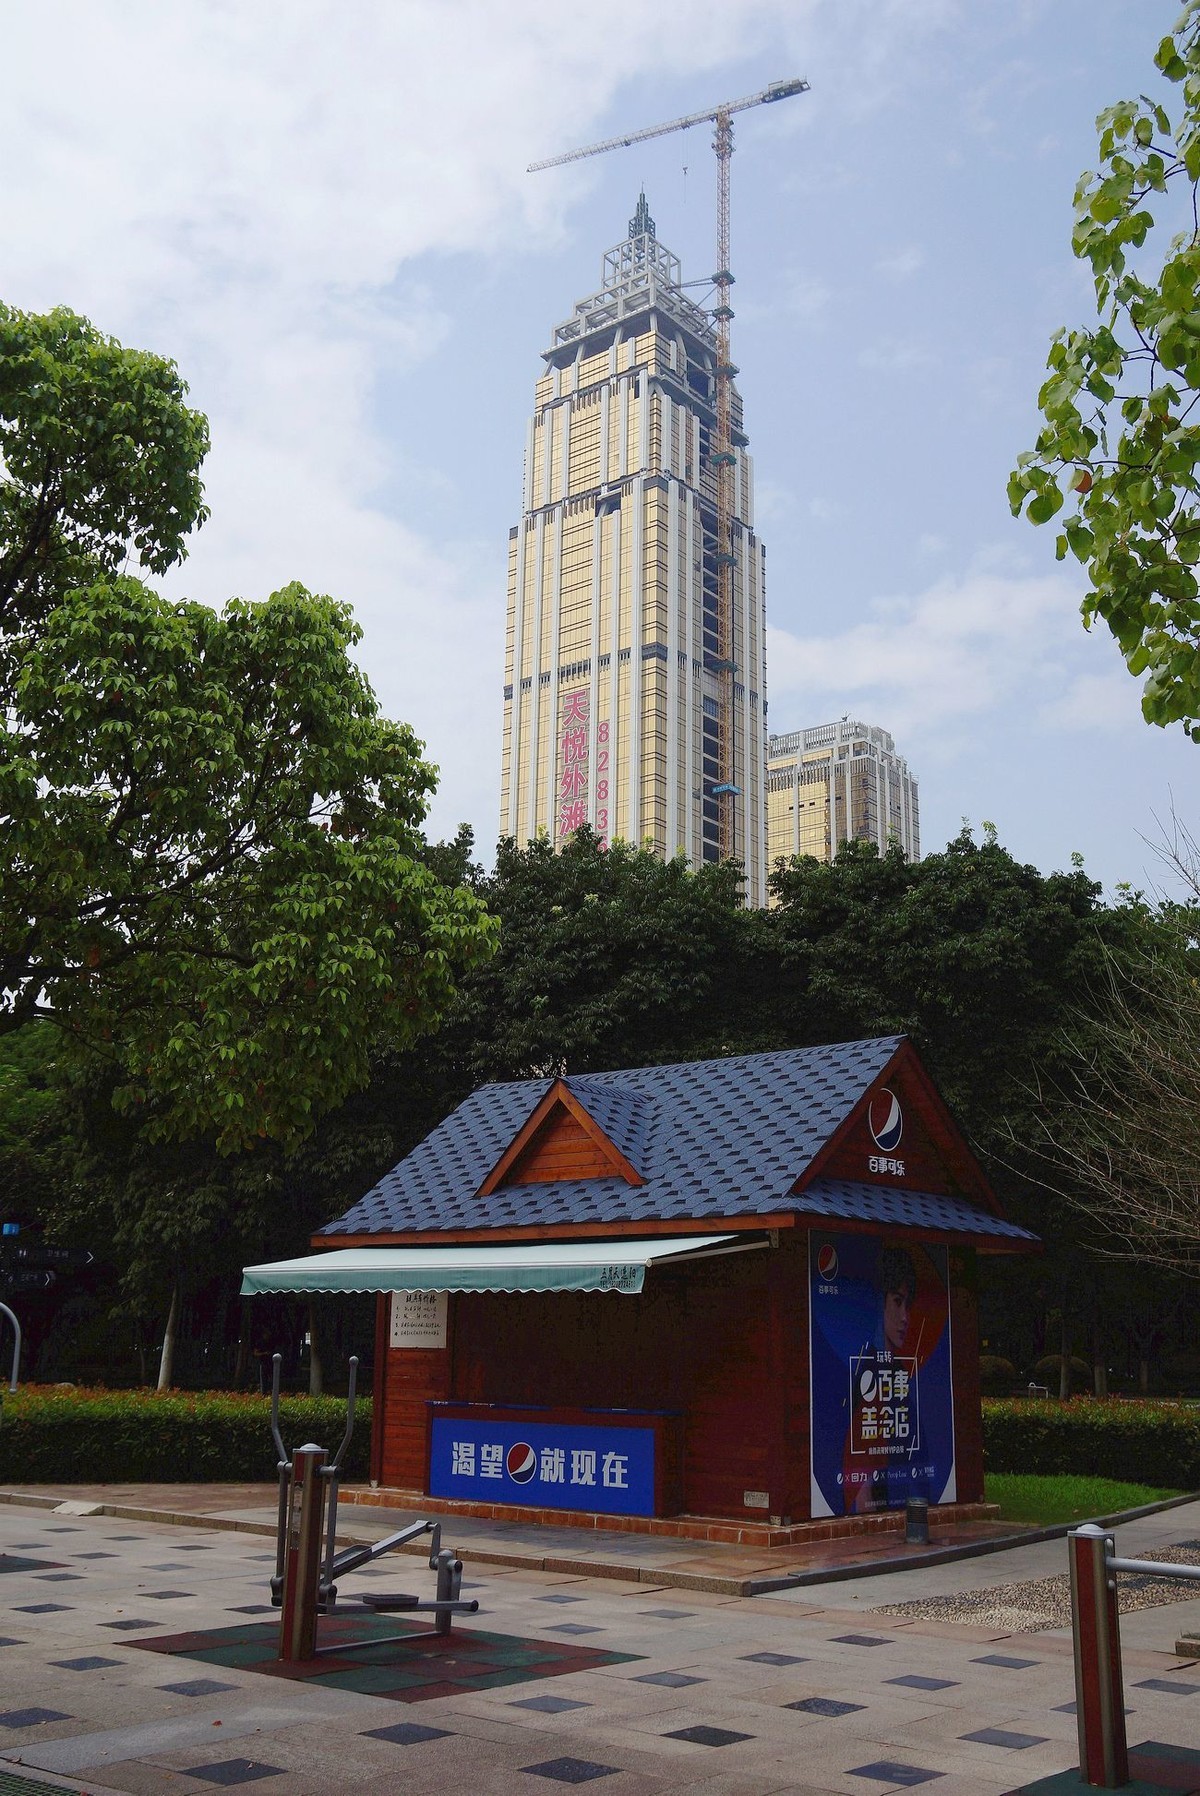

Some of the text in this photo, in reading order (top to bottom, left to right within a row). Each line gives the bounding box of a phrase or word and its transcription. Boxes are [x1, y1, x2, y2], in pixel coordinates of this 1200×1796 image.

[559, 689, 589, 837] 天悦外滩
[868, 1155, 906, 1177] 百事可乐
[876, 1351, 892, 1363] 玩转
[878, 1369, 910, 1402] 百事
[860, 1405, 910, 1440] 盖念店
[451, 1441, 629, 1489] 渴望 就现在
